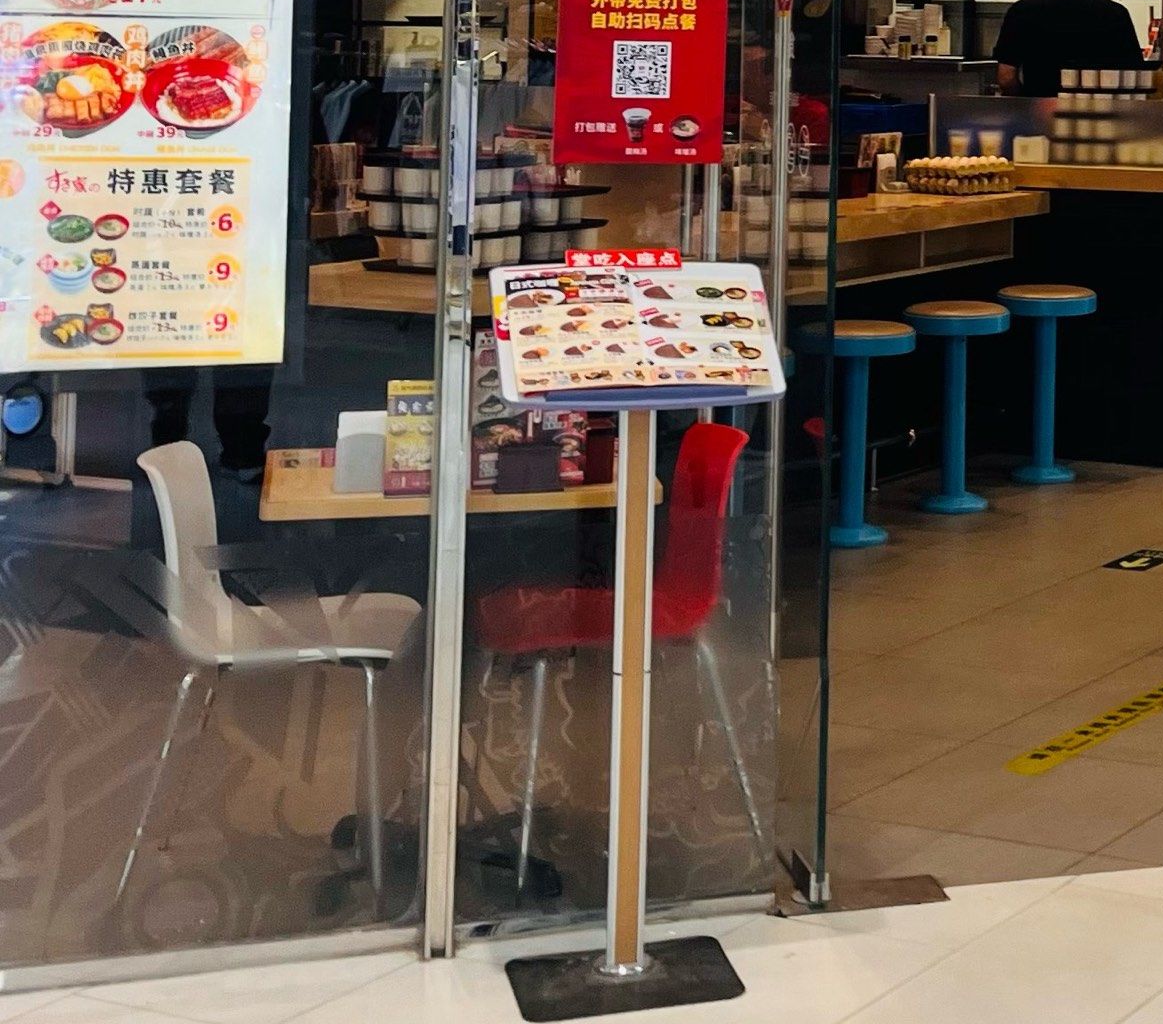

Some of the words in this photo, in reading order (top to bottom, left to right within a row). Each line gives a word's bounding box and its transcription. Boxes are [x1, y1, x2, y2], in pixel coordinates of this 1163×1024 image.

[591, 12, 697, 31] 自助扫码点餐
[107, 168, 235, 195] 特惠套餐
